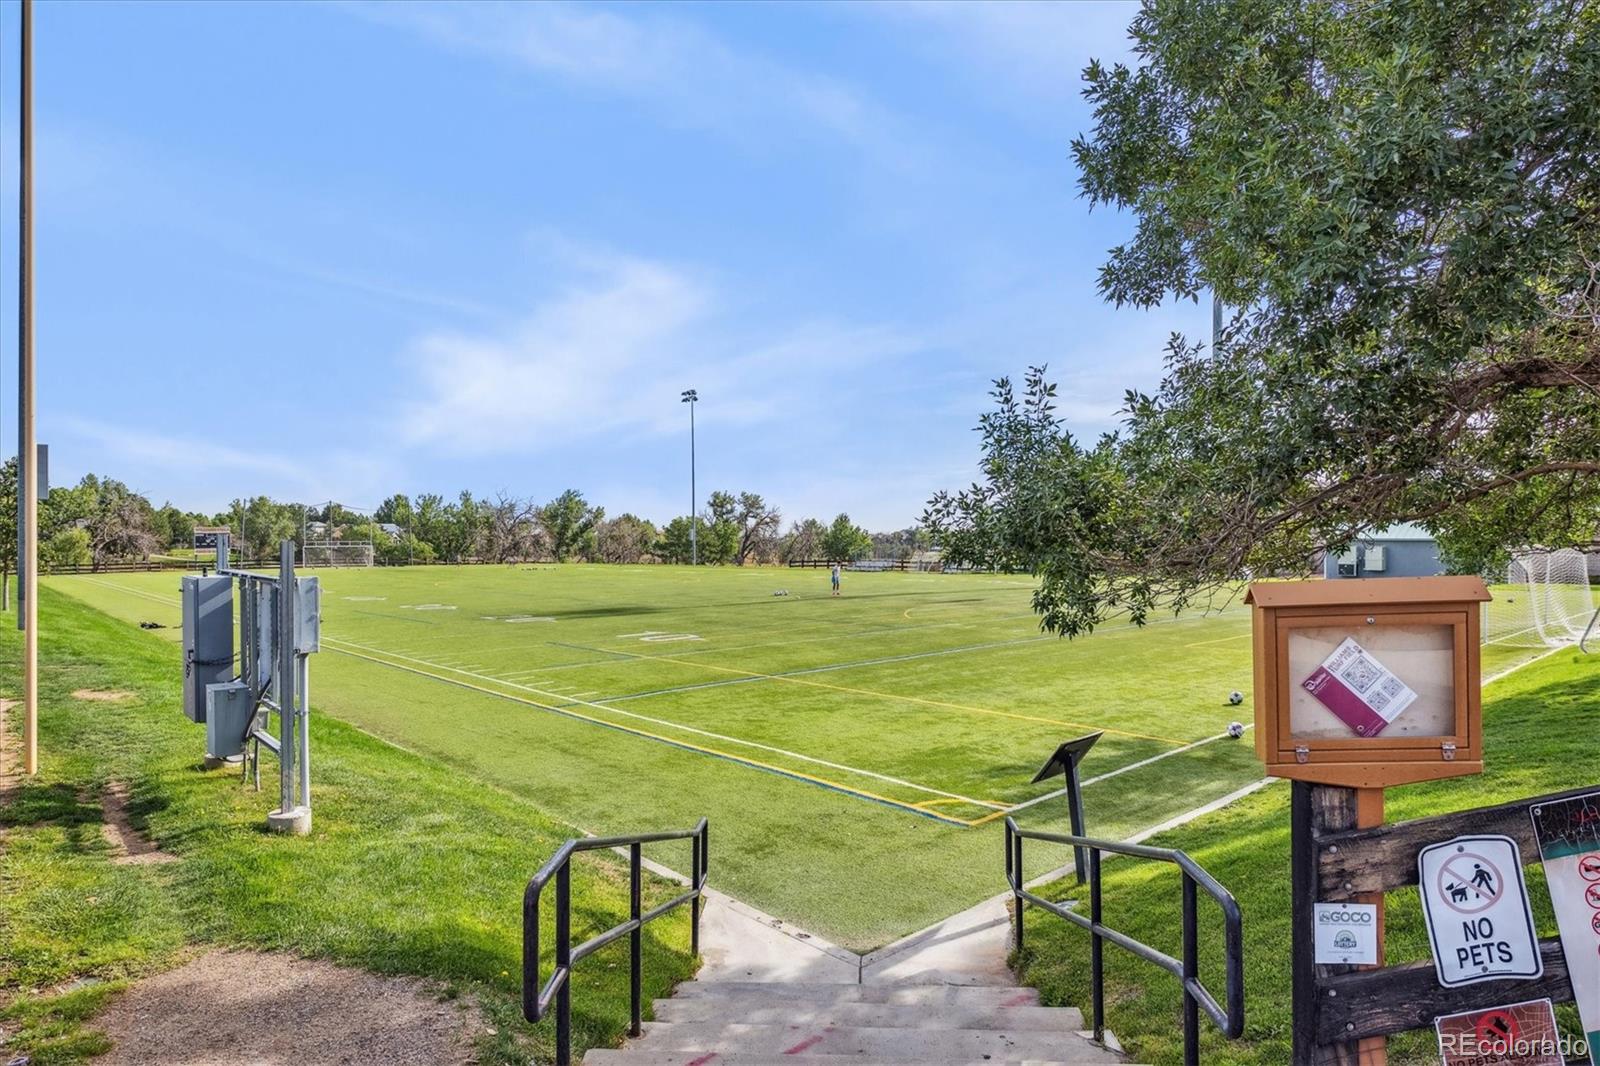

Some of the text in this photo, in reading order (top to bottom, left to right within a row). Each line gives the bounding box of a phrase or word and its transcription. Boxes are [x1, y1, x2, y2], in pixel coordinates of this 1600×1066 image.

[1330, 911, 1372, 923] GOCO
[1462, 917, 1494, 942] NO
[1455, 941, 1513, 969] PETS
[1468, 1055, 1498, 1066] PETS
